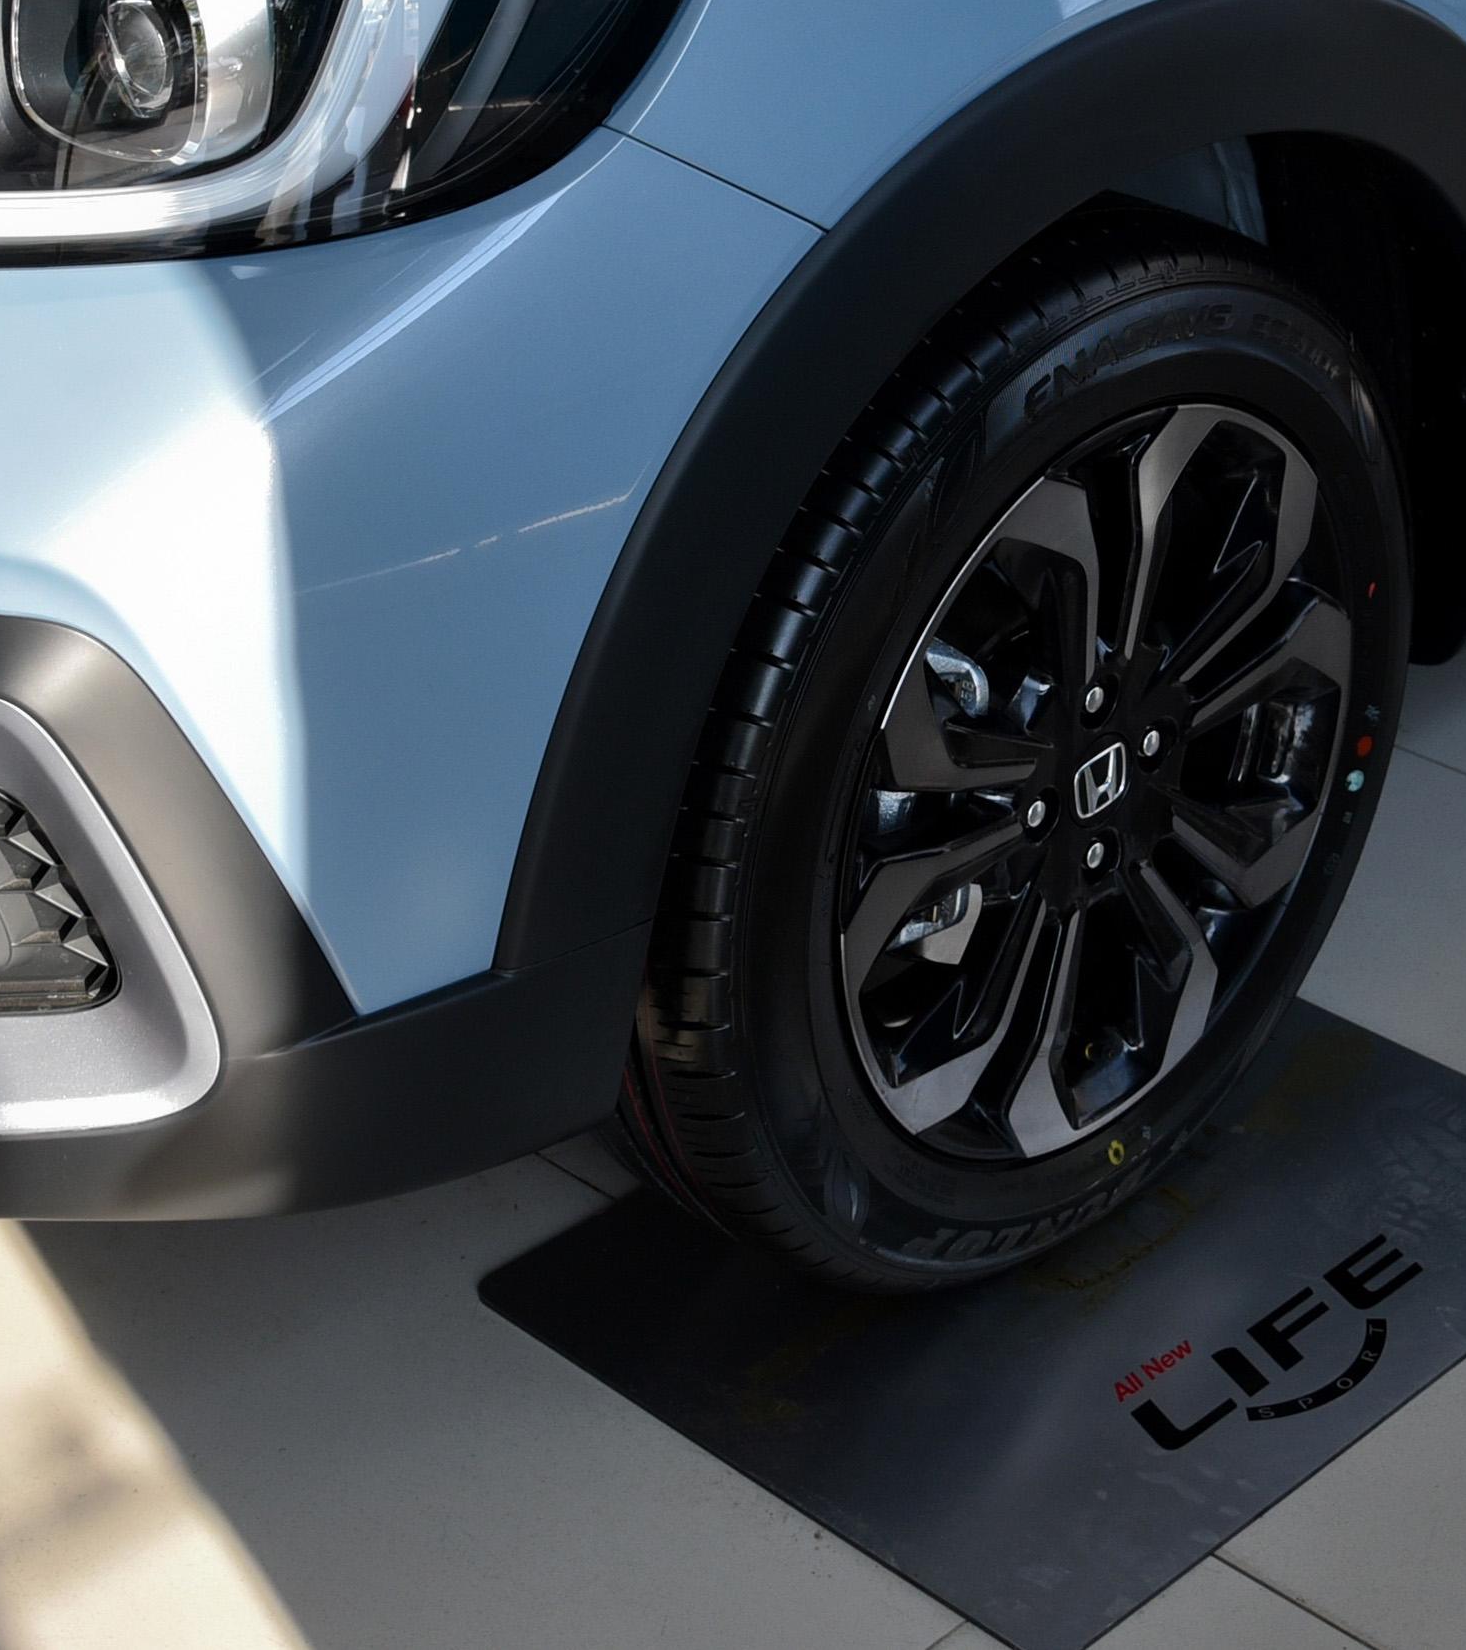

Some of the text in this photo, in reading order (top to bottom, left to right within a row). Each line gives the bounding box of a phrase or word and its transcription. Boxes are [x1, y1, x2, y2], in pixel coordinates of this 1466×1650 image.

[1113, 1339, 1193, 1403] All New
[1130, 1233, 1424, 1451] LIFE
[1256, 1323, 1385, 1420] SPORT
